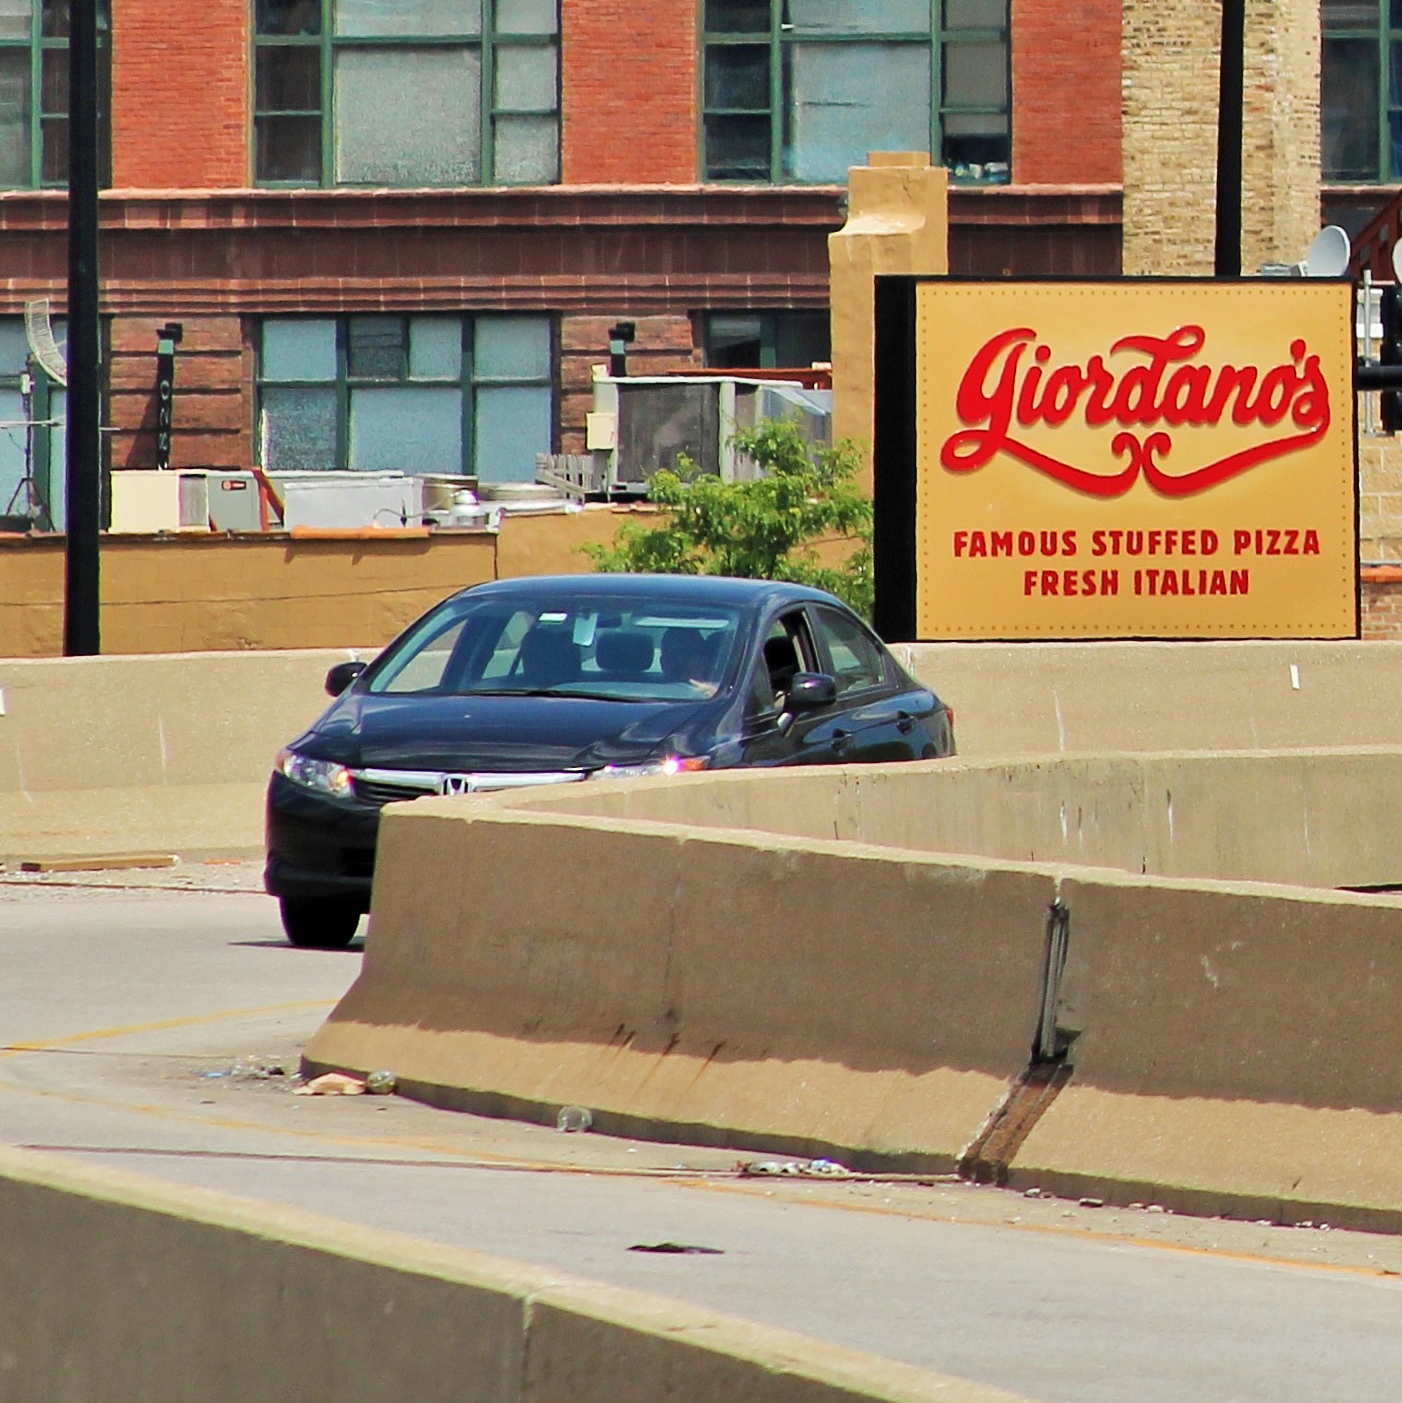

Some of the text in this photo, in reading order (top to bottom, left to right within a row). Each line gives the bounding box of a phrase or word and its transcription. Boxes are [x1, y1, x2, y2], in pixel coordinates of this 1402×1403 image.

[940, 325, 1331, 496] Giordano's
[953, 529, 1321, 557] FAMOUS STUFFED PIZZA
[1023, 570, 1250, 596] FRESH ITALIAN
